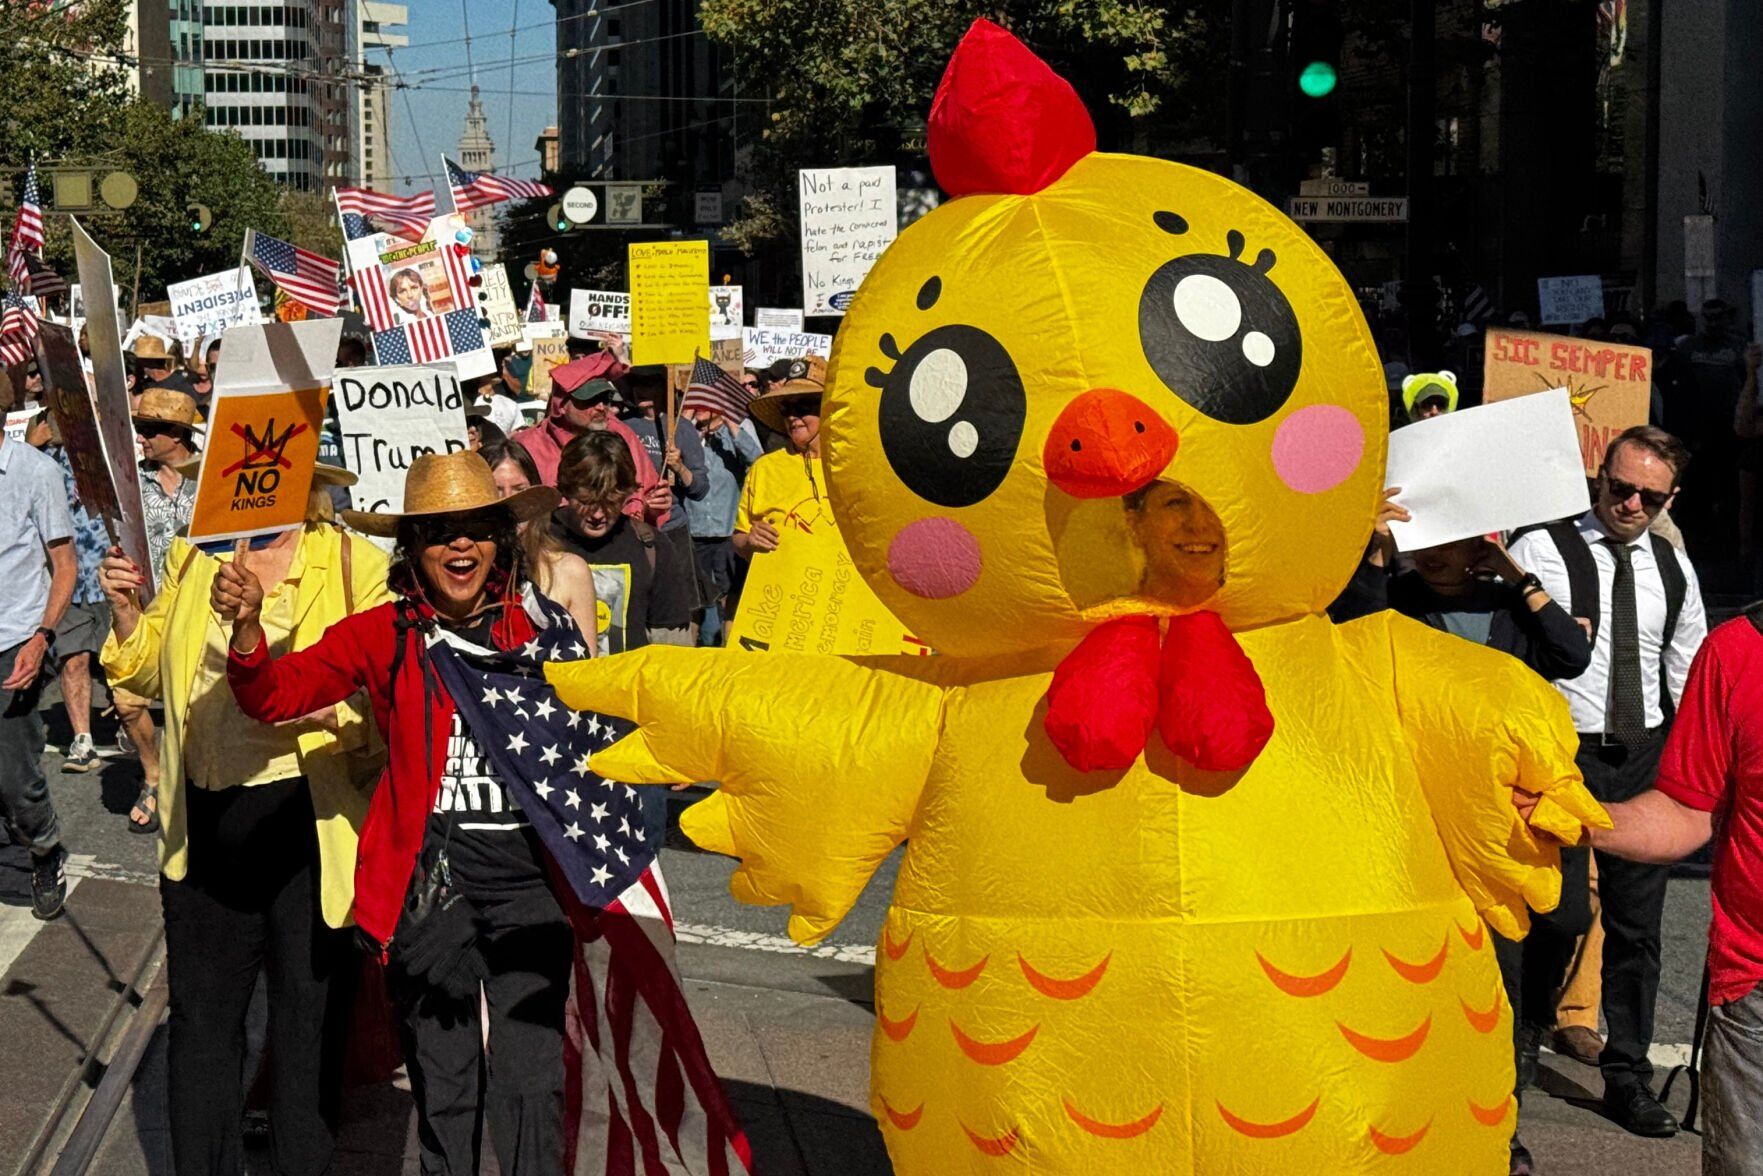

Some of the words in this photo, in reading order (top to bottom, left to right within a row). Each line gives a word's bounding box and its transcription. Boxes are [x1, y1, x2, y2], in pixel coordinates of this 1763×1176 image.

[802, 172, 834, 196] Not
[859, 177, 882, 197] paid
[869, 199, 882, 210] I
[1294, 201, 1318, 216] NEW
[1327, 202, 1403, 216] MONTGOMERY
[805, 221, 827, 236] hate
[829, 224, 846, 235] the
[804, 239, 828, 254] felon
[833, 241, 849, 250] and
[852, 237, 891, 252] rapist
[829, 252, 849, 264] for
[808, 271, 826, 290] No
[176, 286, 253, 318] PRESIDENT
[588, 293, 630, 305] HANDS
[588, 303, 630, 320] OFF!
[749, 329, 770, 345] WE
[772, 331, 787, 345] the
[789, 332, 829, 349] PEOPLE
[763, 345, 782, 354] WILL
[785, 347, 802, 356] NOT
[1493, 333, 1541, 366] SIC
[1550, 342, 1648, 383] SEMPER
[340, 374, 463, 413] Donald
[234, 468, 281, 498] NO
[230, 494, 277, 512] KINGS
